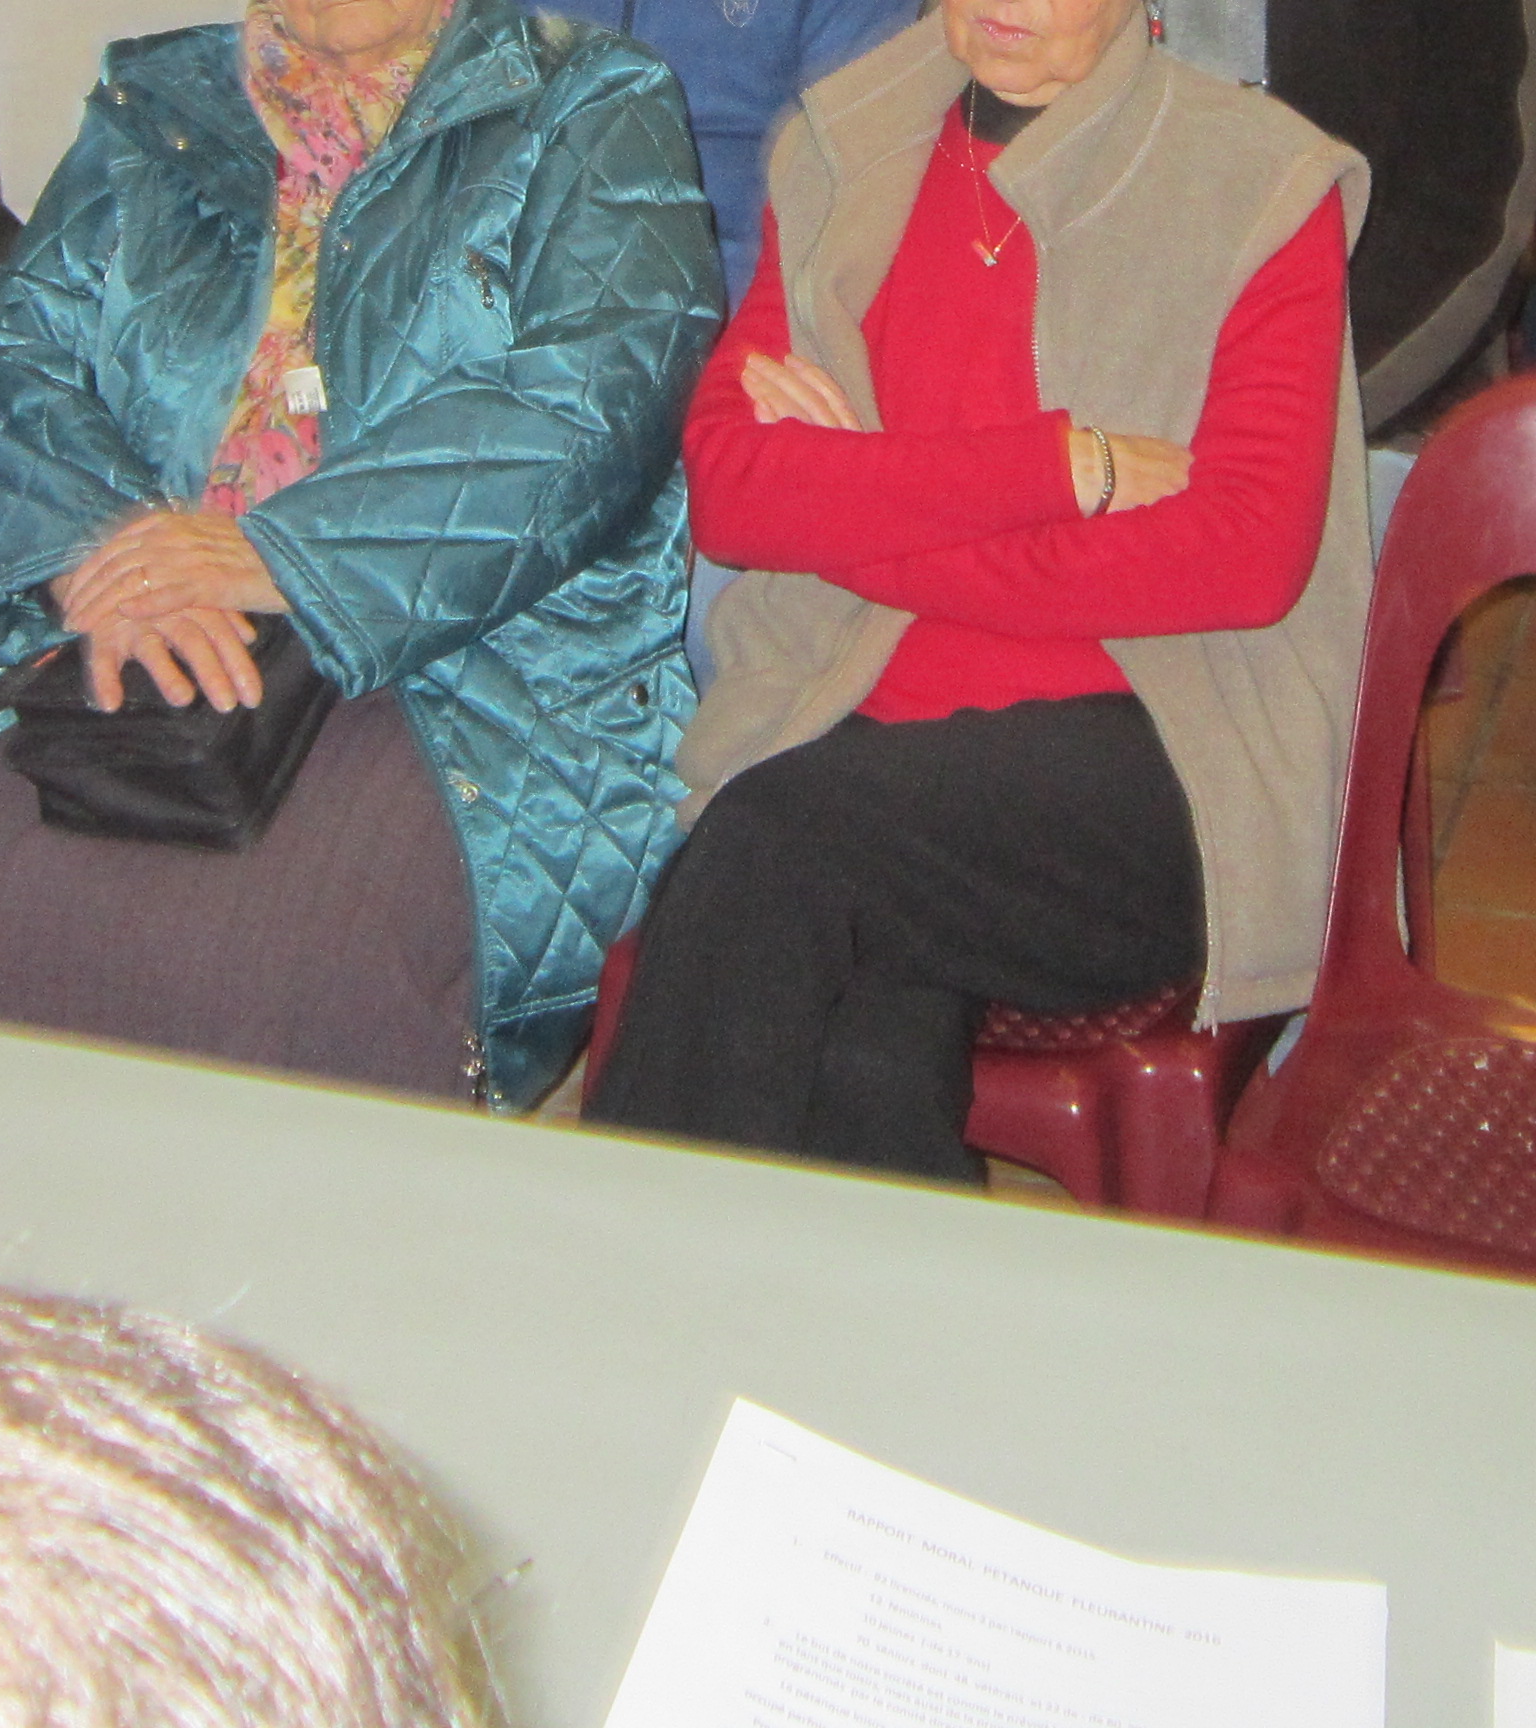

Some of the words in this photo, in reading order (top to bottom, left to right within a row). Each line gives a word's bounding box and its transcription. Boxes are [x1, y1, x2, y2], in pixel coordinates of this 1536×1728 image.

[847, 1509, 914, 1544] RAPPORT
[922, 1540, 974, 1570] MORAL
[984, 1564, 1062, 1602] PETANQUE
[1072, 1597, 1174, 1636] FLEURANTINE
[1184, 1629, 1220, 1646] 2016
